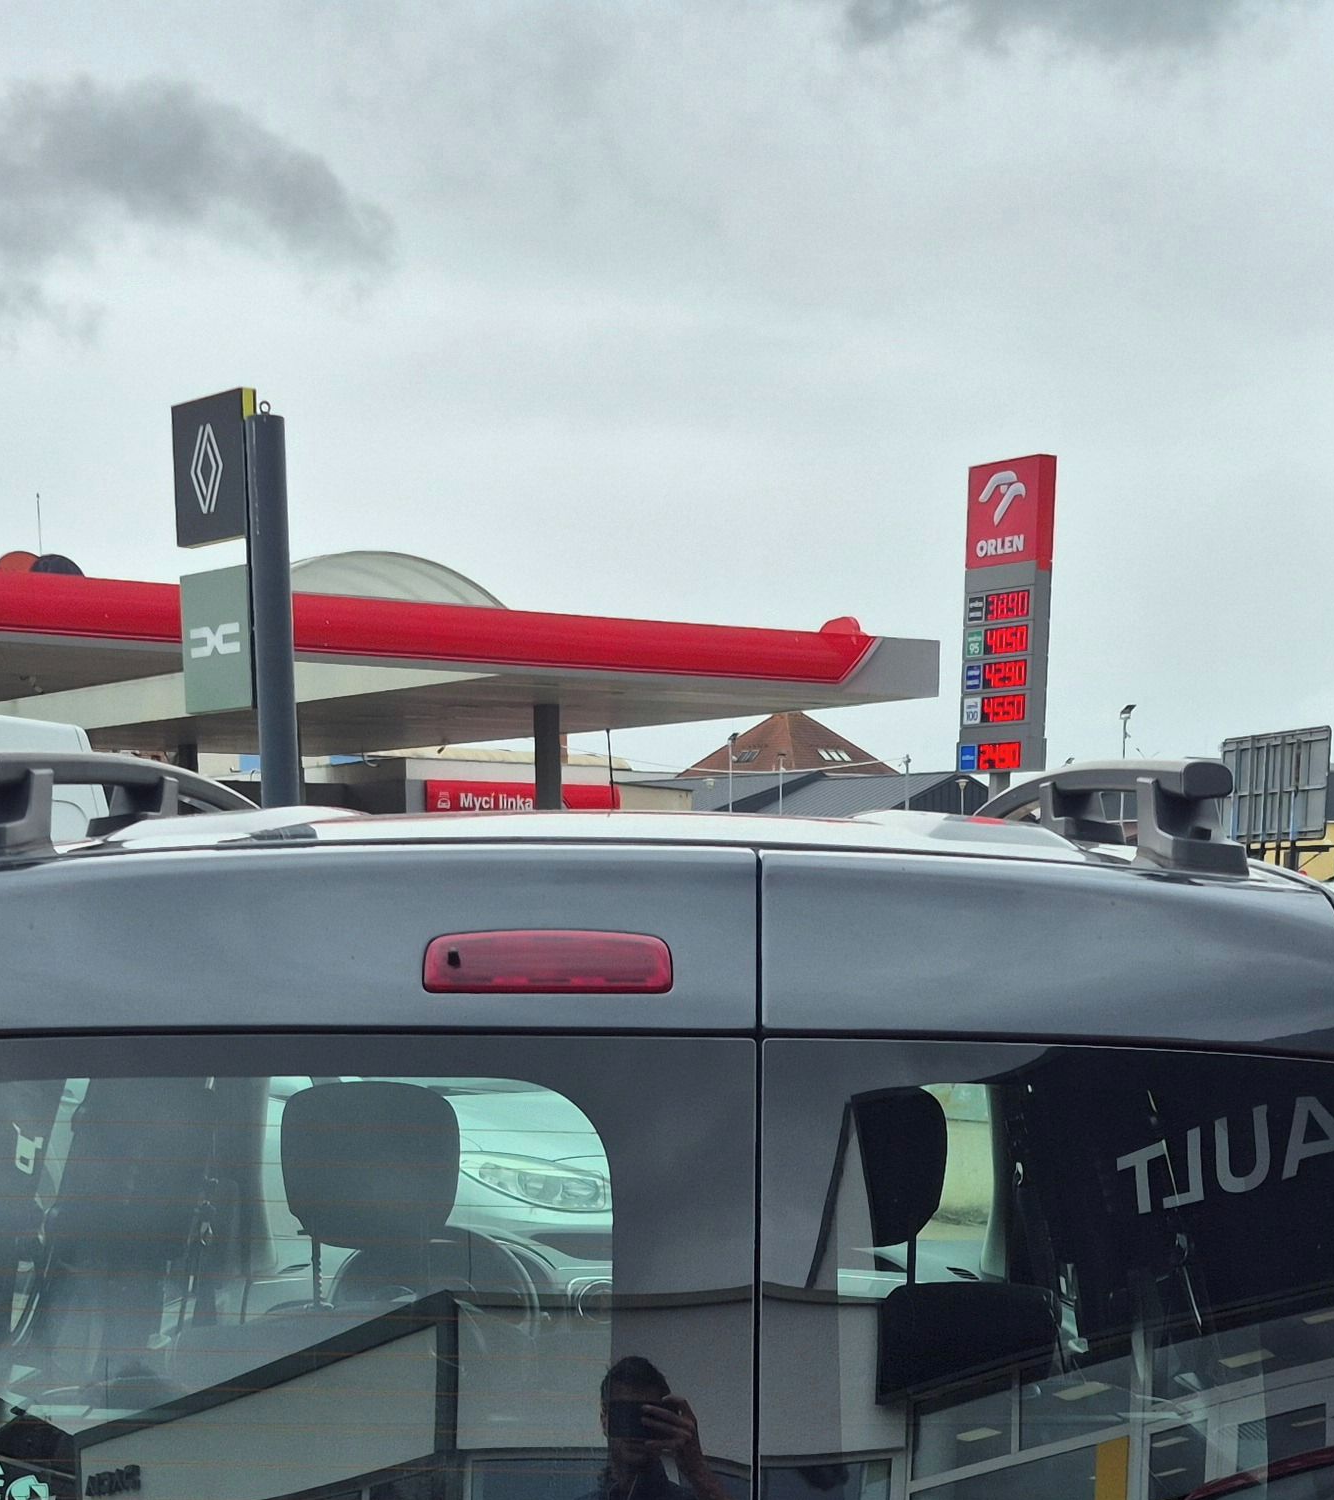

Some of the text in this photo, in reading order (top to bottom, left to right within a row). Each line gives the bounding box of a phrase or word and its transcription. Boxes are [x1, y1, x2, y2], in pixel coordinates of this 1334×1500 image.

[976, 534, 1025, 558] ORLEN
[969, 642, 980, 654] 95
[459, 792, 534, 811] Mycí linka
